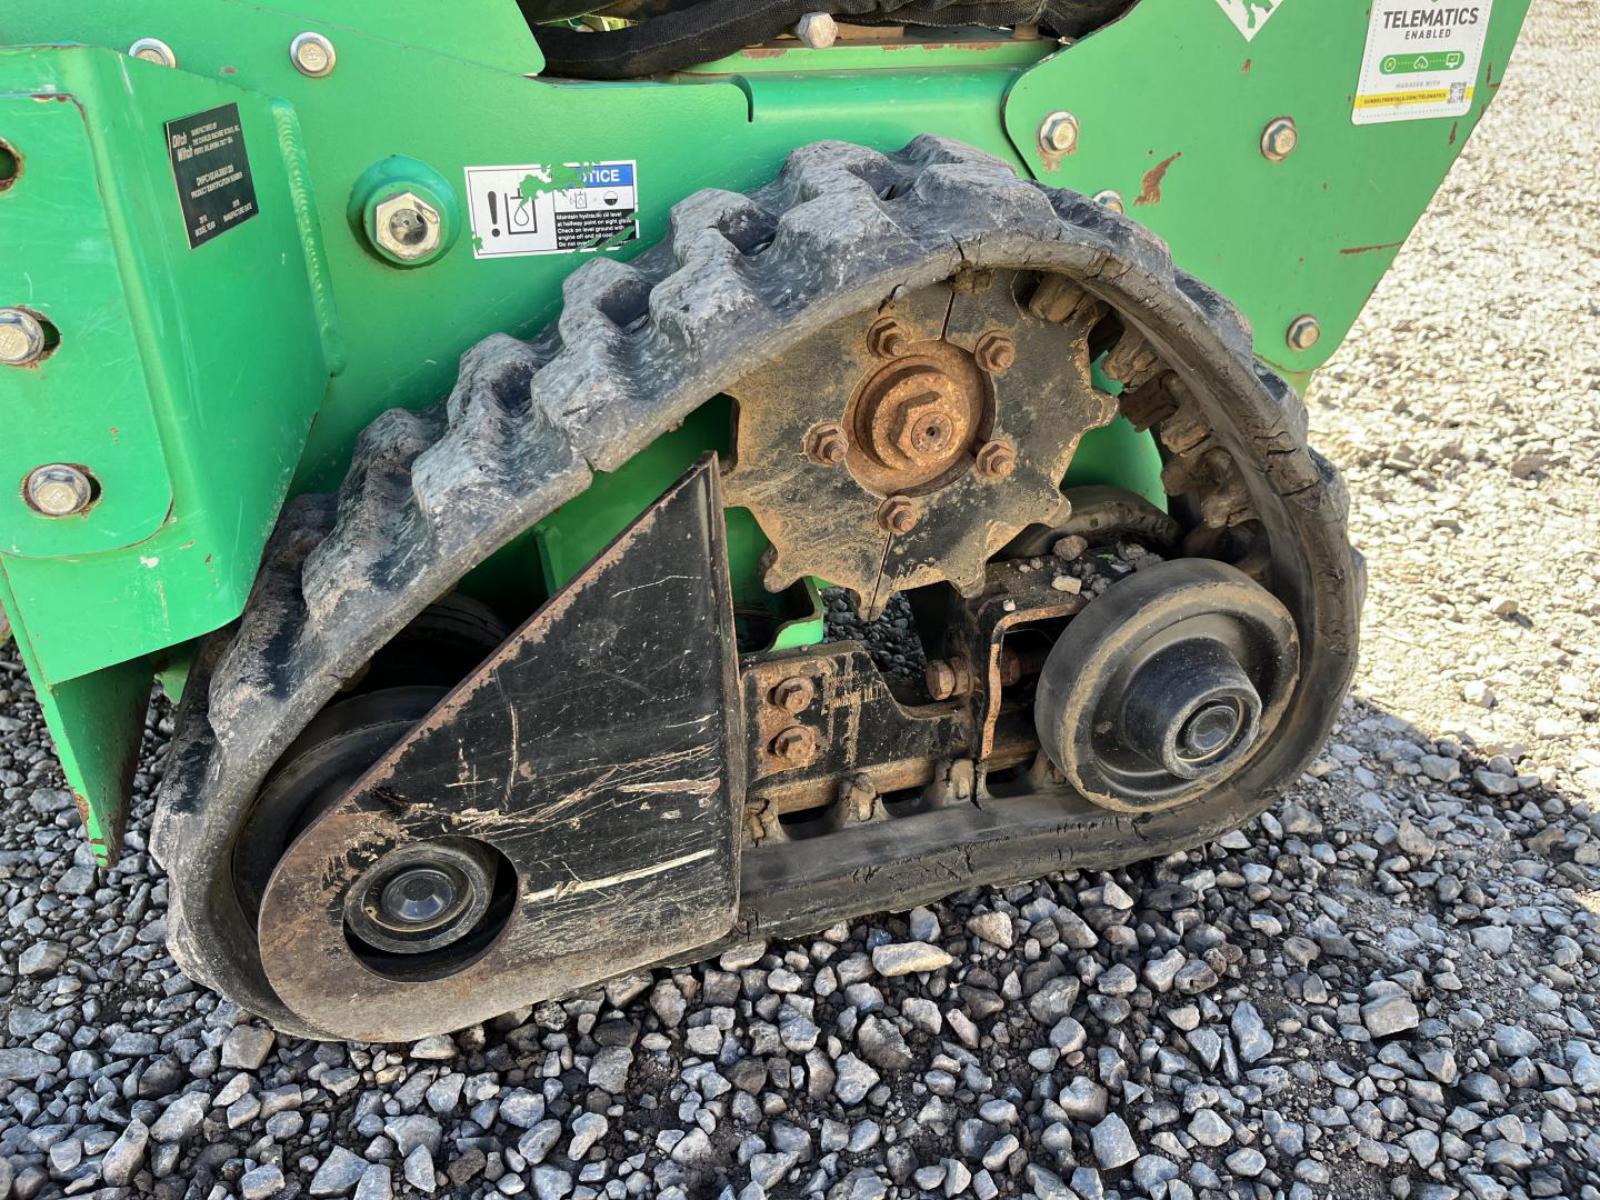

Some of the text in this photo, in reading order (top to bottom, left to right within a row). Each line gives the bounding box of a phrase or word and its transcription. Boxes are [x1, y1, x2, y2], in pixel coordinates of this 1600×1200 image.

[1383, 7, 1480, 29] TELEMATICS
[1405, 28, 1451, 40] ENABLED
[171, 132, 187, 148] Ditch
[177, 145, 193, 162] Witch
